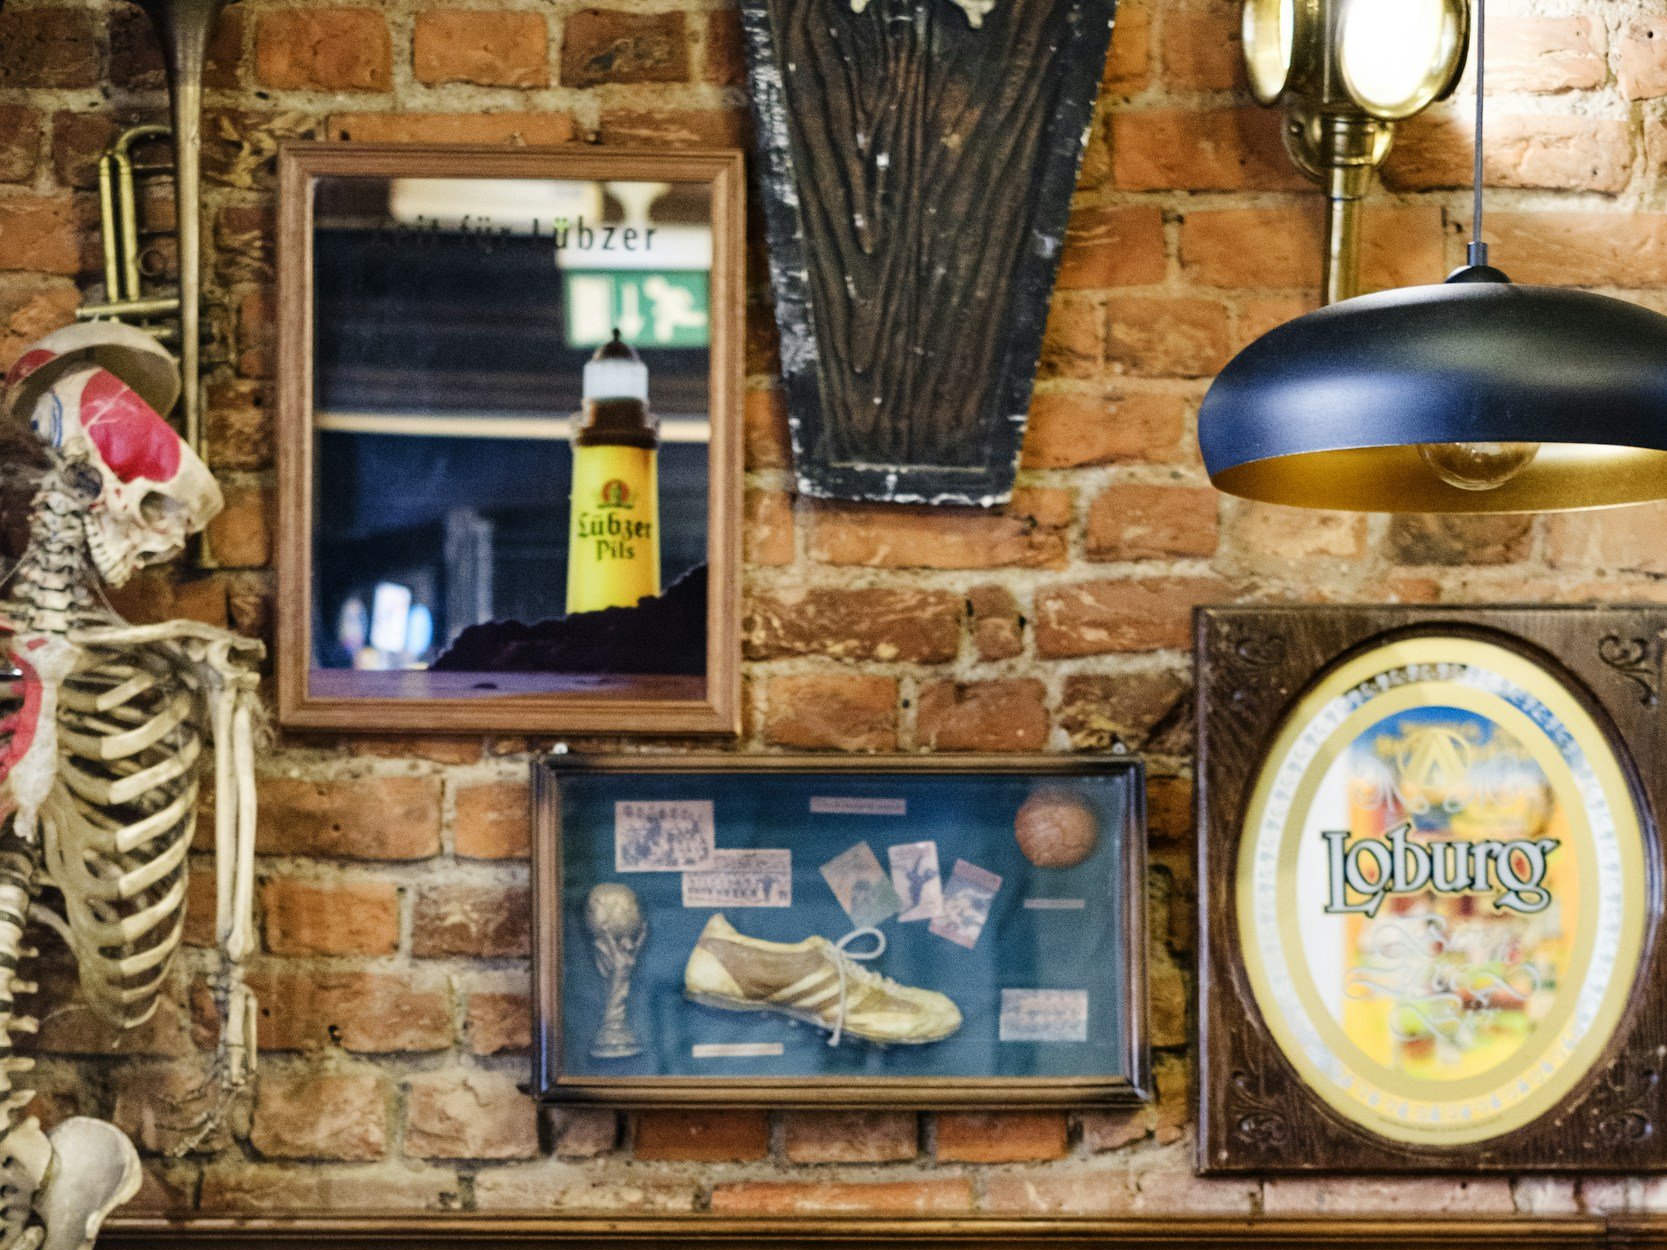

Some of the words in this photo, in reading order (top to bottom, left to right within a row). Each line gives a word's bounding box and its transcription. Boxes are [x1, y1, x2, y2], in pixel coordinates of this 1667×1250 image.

[533, 215, 657, 251] Lübzer
[597, 539, 635, 561] Pils
[1320, 822, 1561, 919] Loburg
